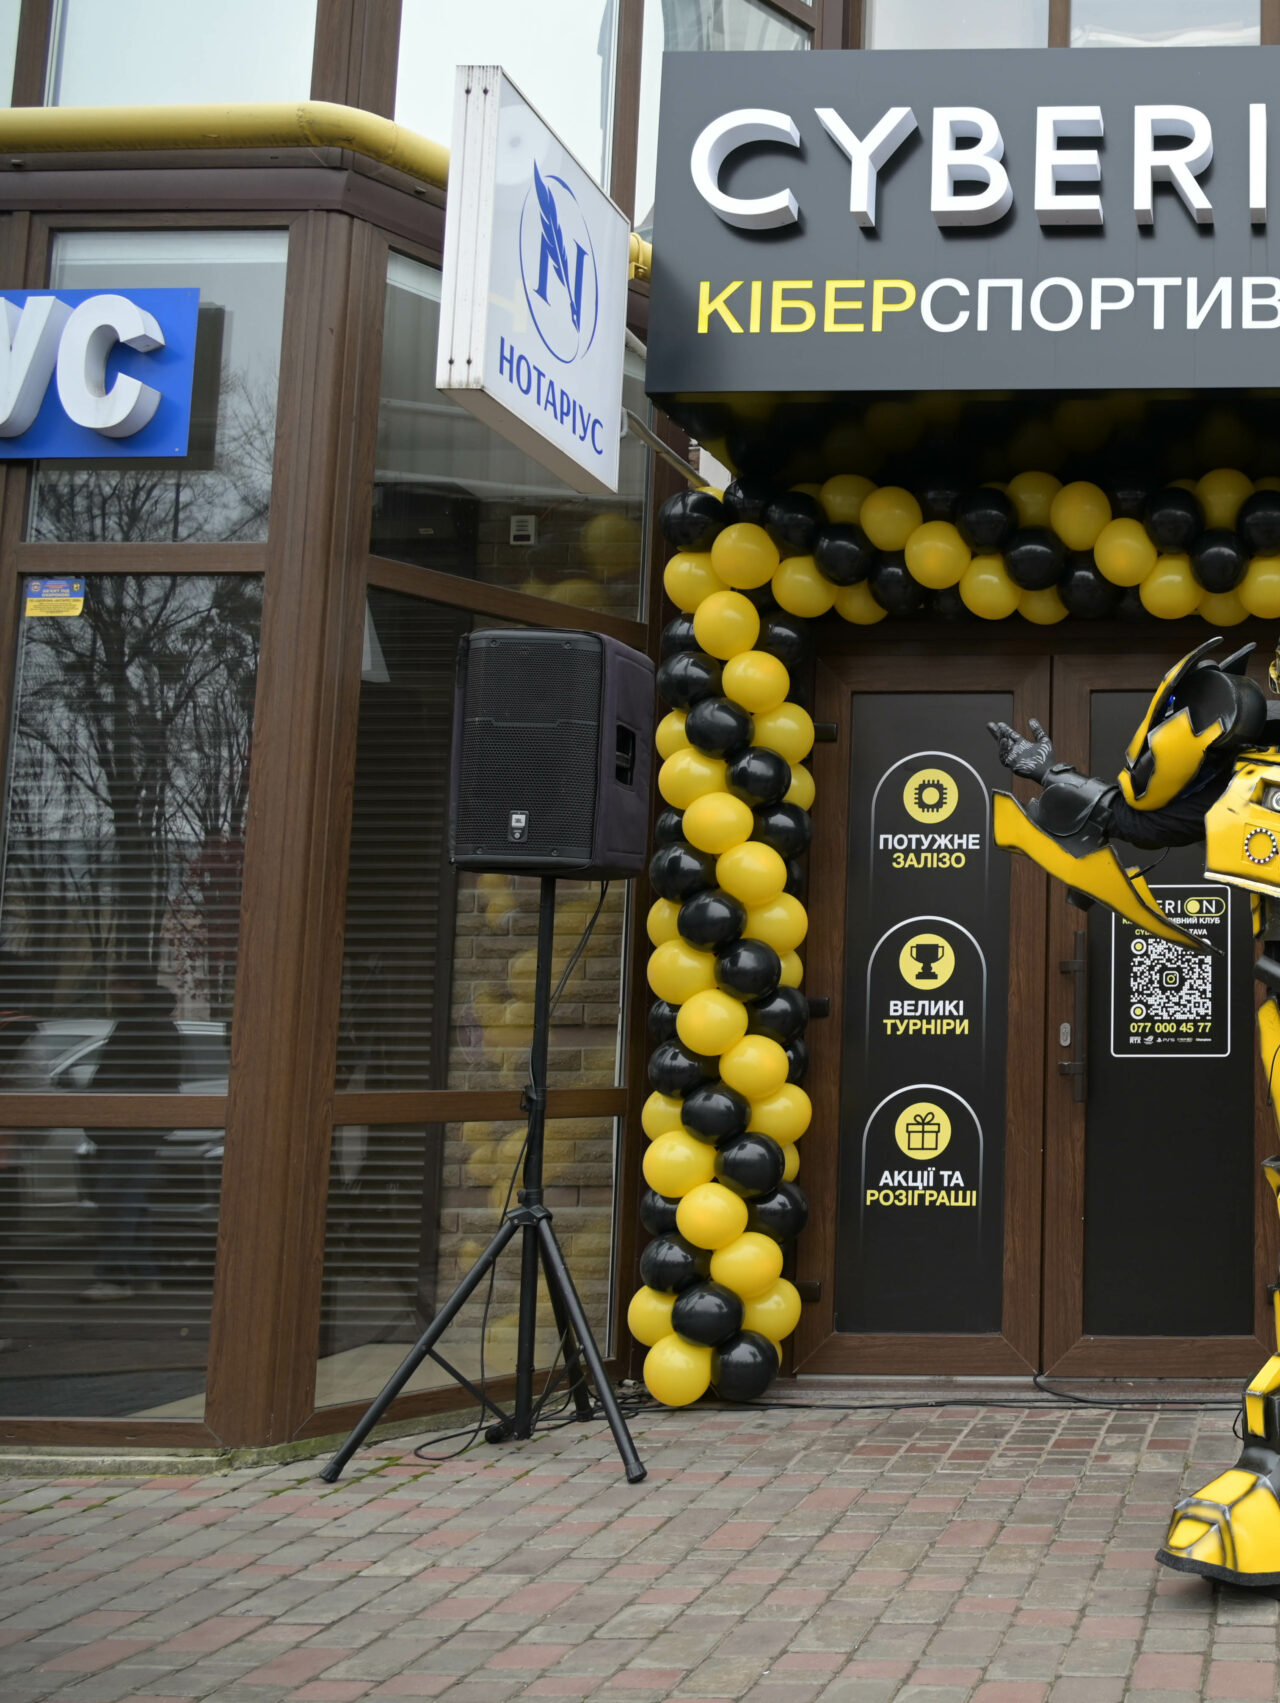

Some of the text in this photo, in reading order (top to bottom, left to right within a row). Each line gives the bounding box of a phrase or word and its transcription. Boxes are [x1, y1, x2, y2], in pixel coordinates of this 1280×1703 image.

[500, 335, 604, 456] НОТАРІУС
[879, 834, 980, 850] ПОТУЖНЕ
[892, 852, 966, 868] ЗАЛІЗО
[889, 1000, 964, 1016] ВЕЛИКІ
[883, 1019, 969, 1035] ТУРНІРИ
[1130, 1023, 1212, 1033] 077 000 45 77
[879, 1167, 965, 1190] АКЦІЇ ТА
[866, 1189, 977, 1206] РОЗІГРАШІ
